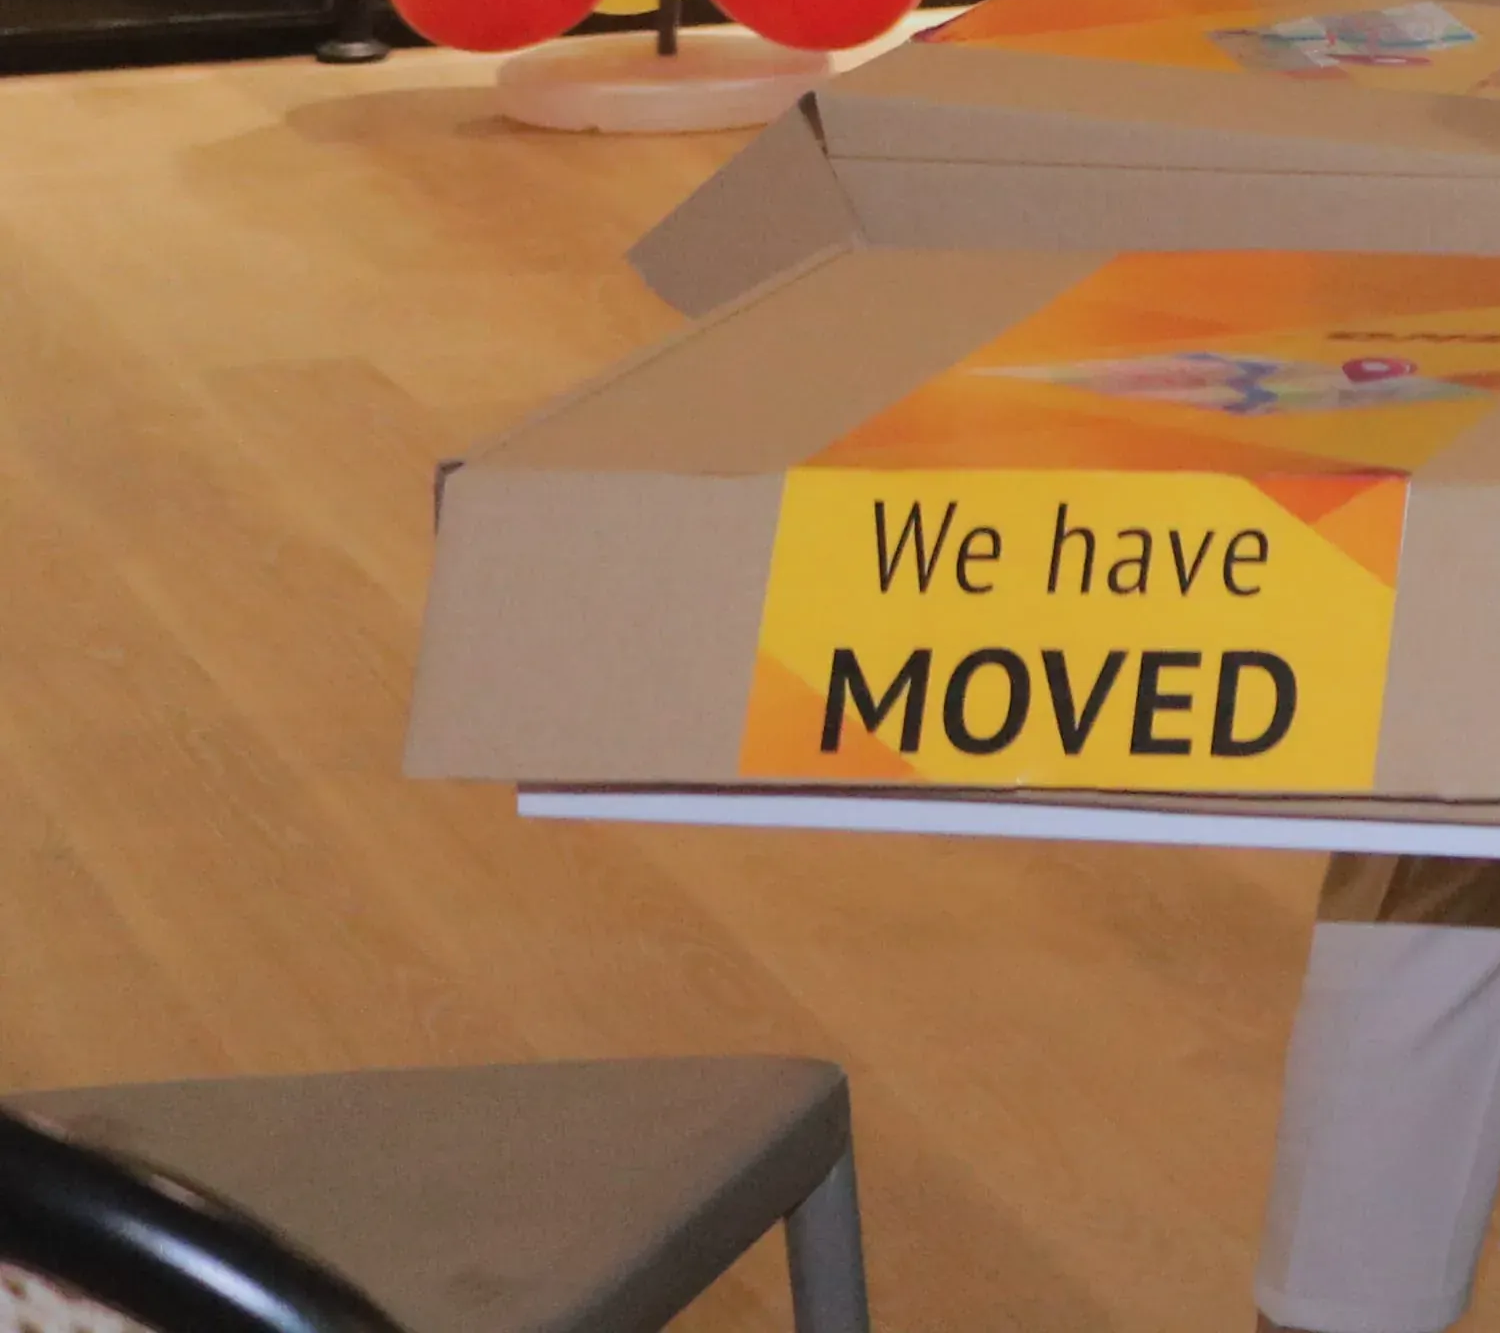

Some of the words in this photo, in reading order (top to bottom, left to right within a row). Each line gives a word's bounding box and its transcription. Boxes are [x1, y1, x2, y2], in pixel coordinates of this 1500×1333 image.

[874, 501, 1001, 594] We
[1047, 503, 1269, 596] have
[821, 647, 1297, 757] MOVED
